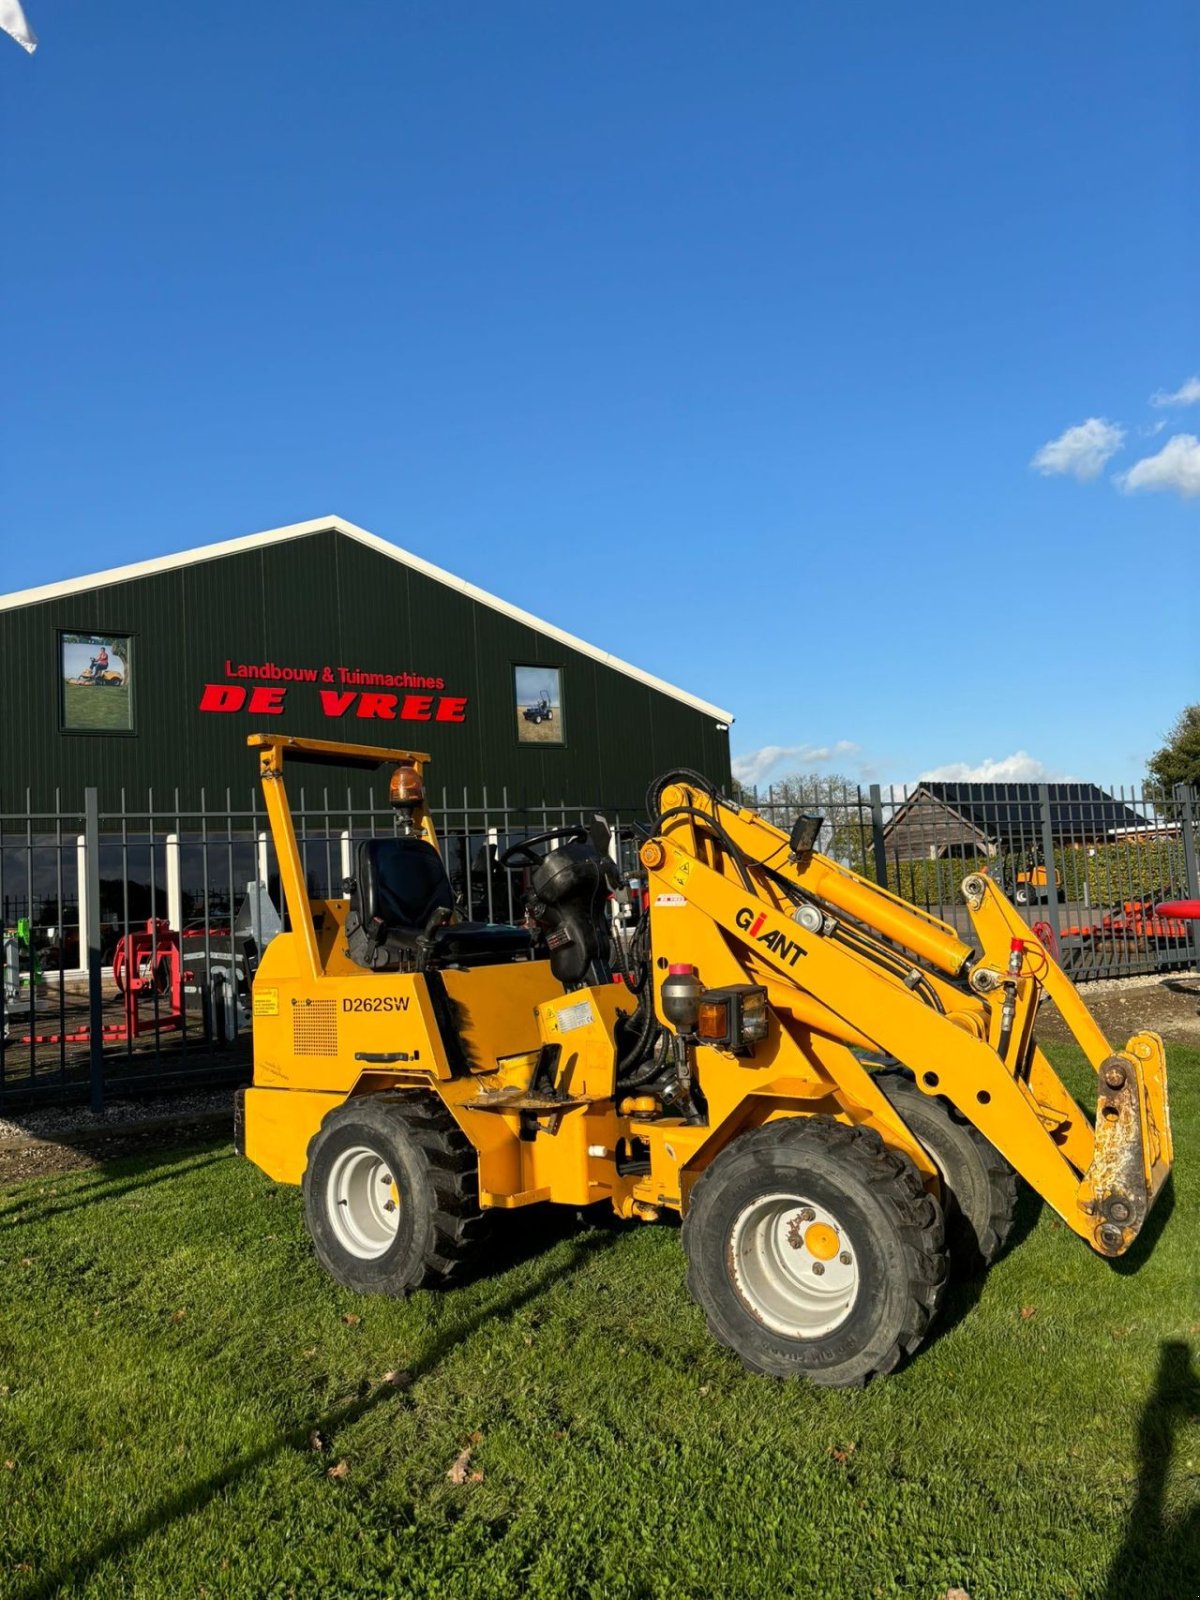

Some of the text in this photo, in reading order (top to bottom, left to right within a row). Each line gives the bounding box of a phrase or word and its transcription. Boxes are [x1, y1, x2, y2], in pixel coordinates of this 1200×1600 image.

[225, 660, 445, 690] Landbouw & Tuinmachines
[199, 683, 468, 722] DE VREE
[342, 997, 410, 1013] D262SW
